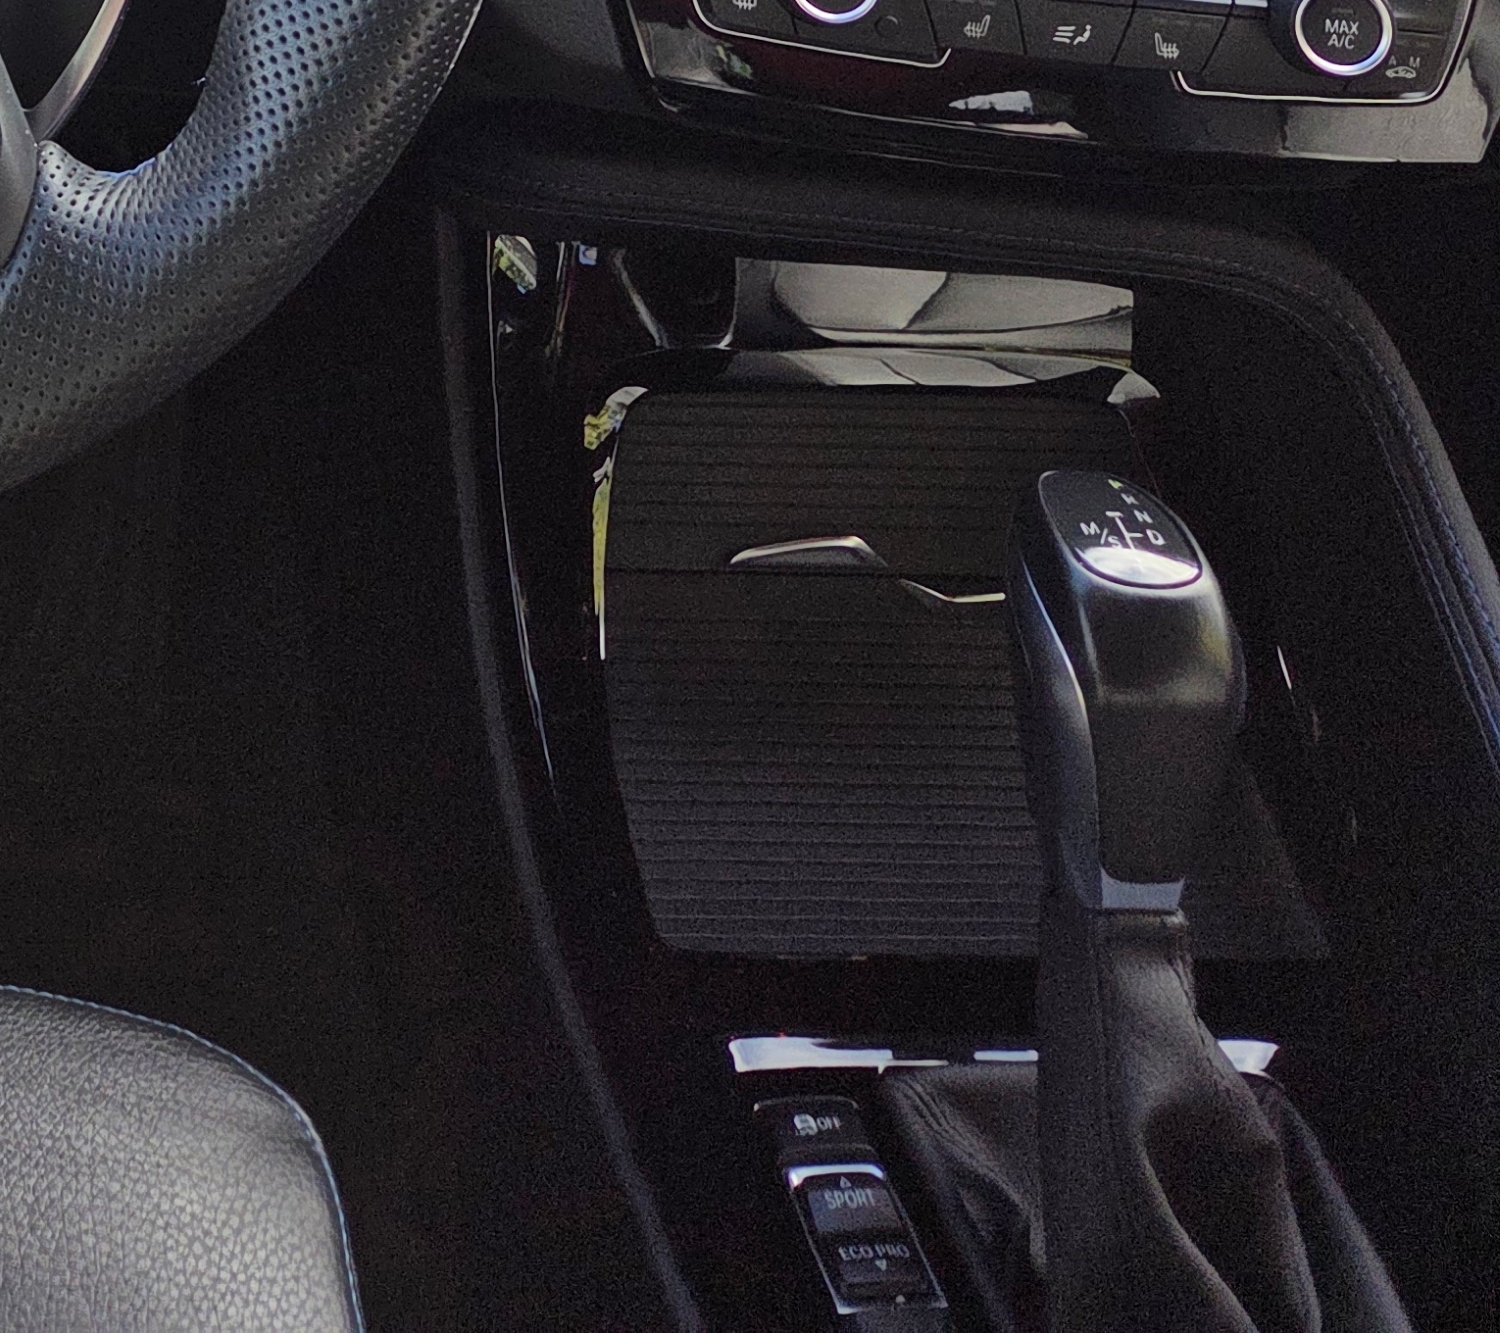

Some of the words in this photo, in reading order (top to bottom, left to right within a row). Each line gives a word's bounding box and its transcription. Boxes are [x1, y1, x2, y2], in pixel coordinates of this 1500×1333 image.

[1325, 19, 1359, 35] MAX
[1327, 33, 1355, 50] A/C
[1133, 509, 1153, 523] N
[1146, 529, 1165, 546] D
[824, 1189, 875, 1210] SPORT
